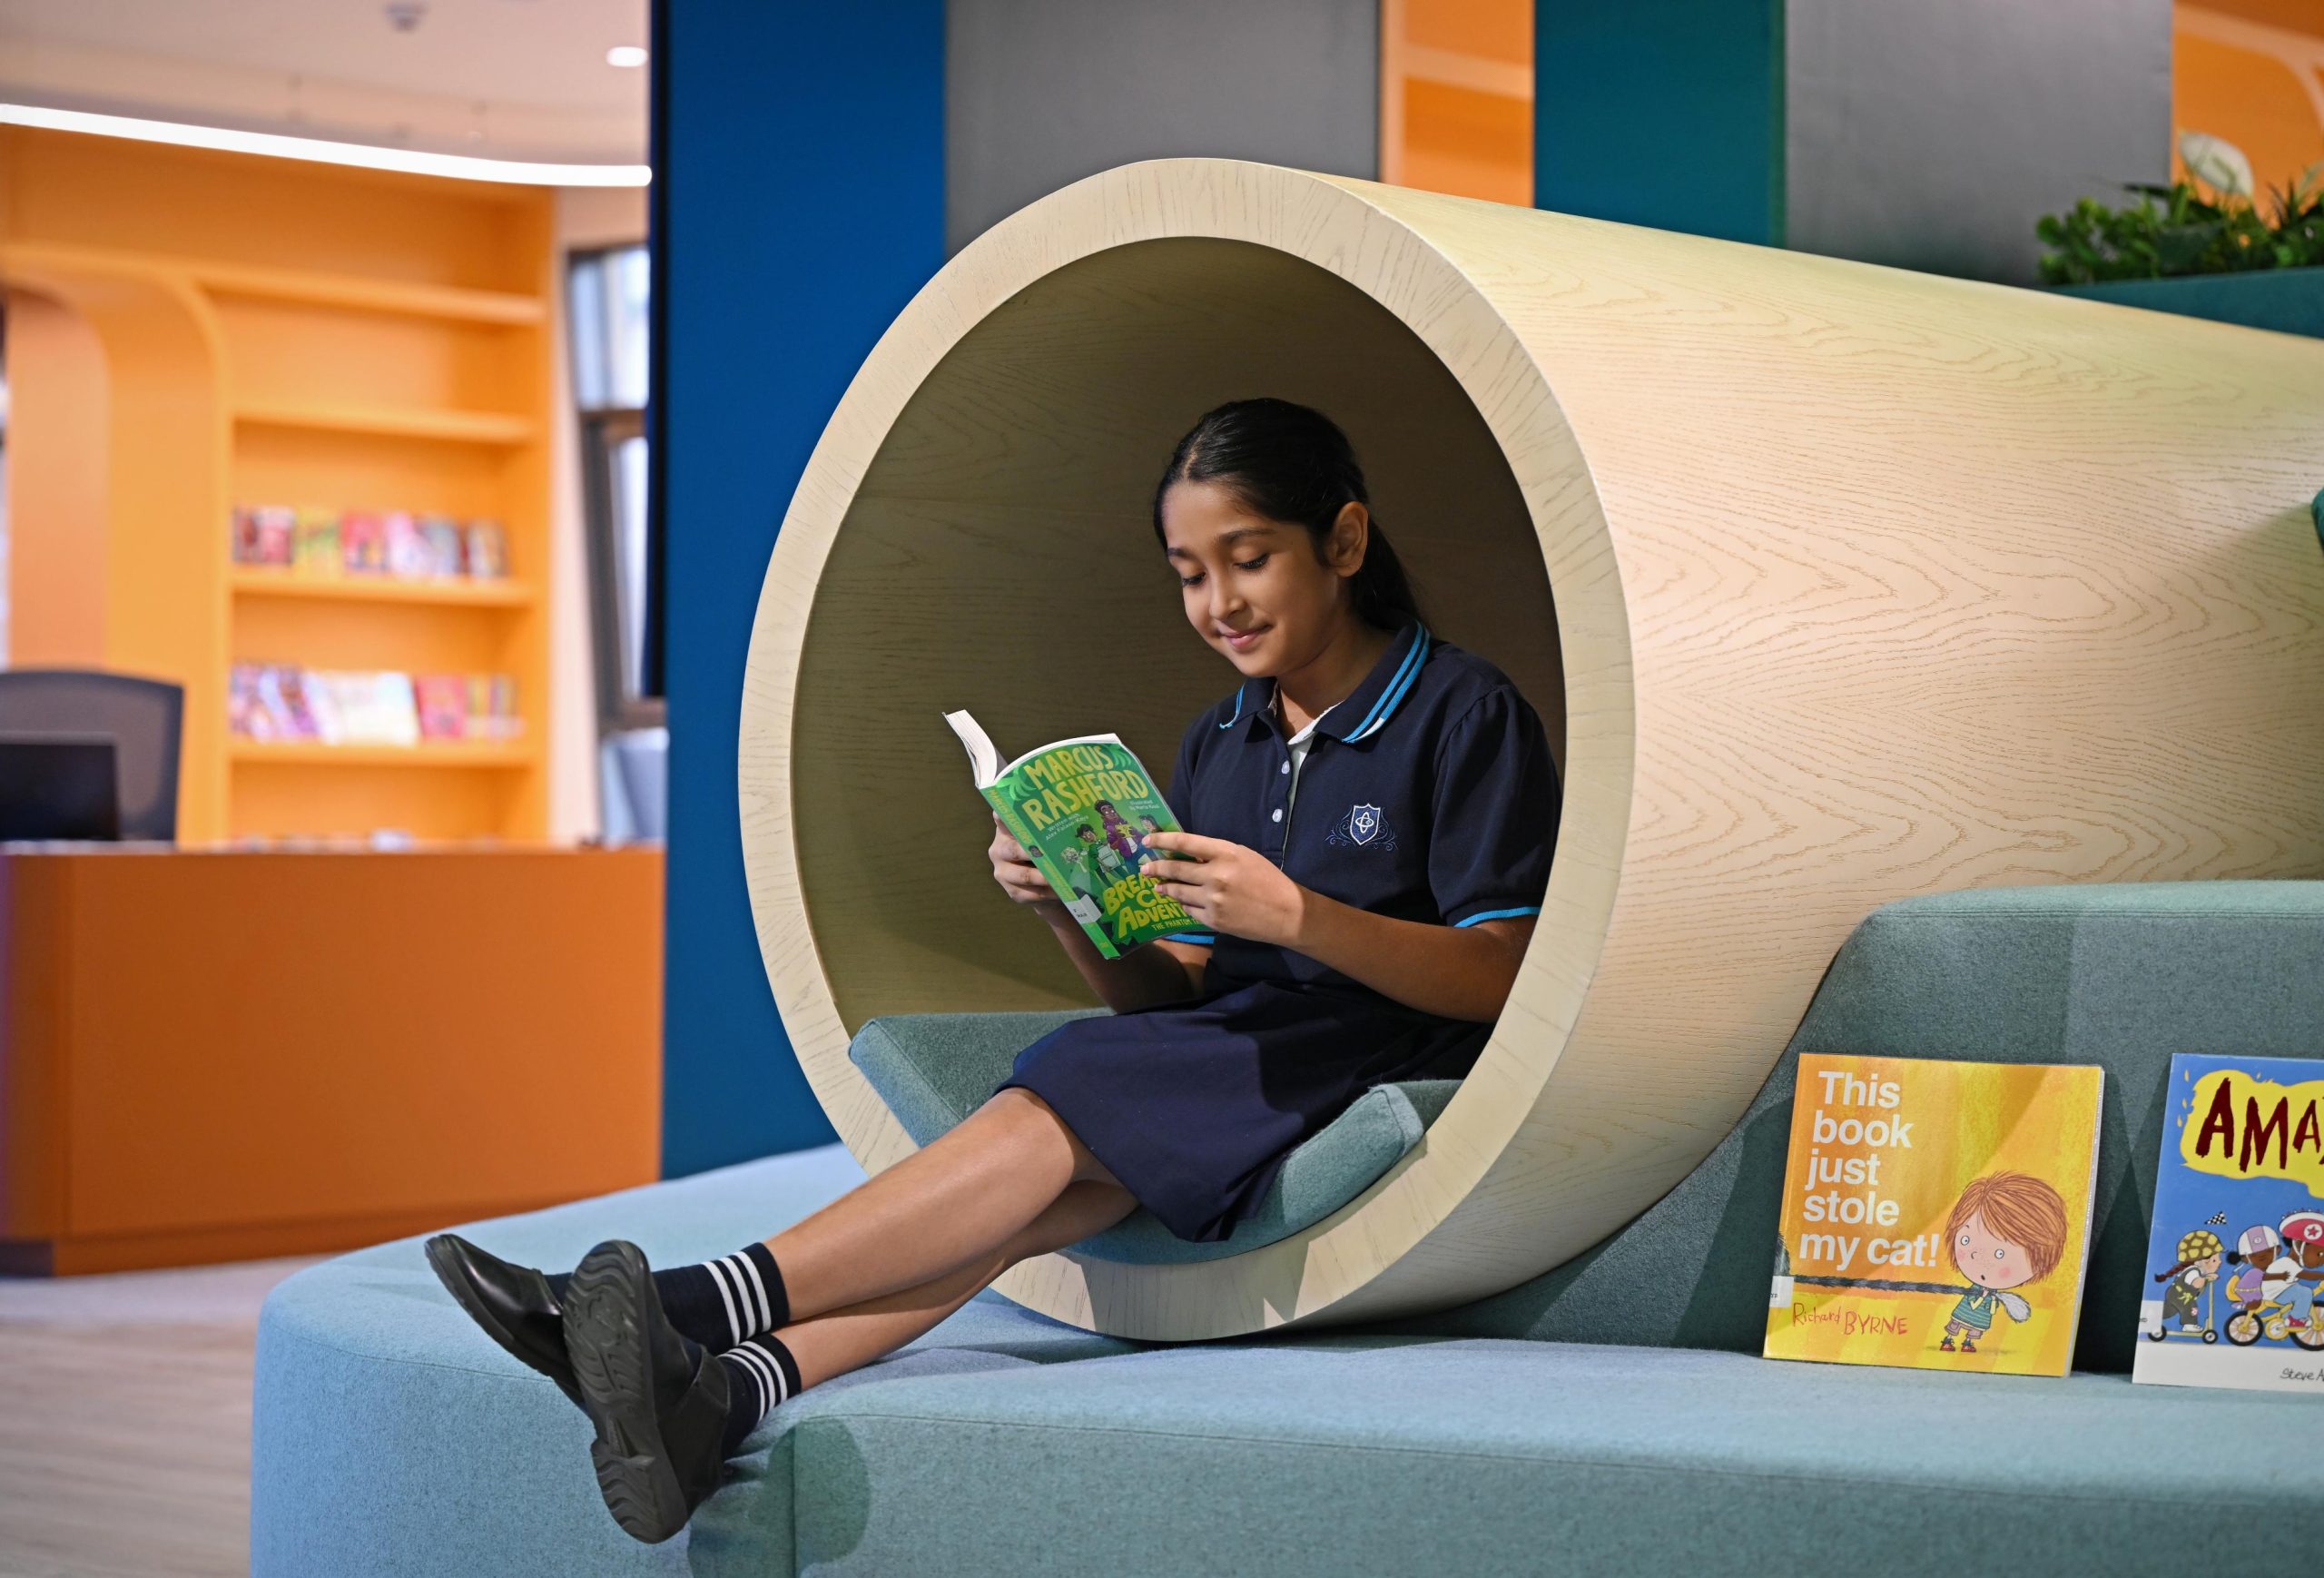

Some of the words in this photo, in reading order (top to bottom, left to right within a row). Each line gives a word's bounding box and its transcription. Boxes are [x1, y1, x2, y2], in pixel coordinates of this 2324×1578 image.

[1023, 745, 1114, 790] MARCUS
[1021, 769, 1148, 832] RASHFORD
[1118, 902, 1188, 939] ADVENT
[1817, 1070, 1901, 1109] This
[1812, 1110, 1915, 1149] book
[2195, 1077, 2324, 1173] AMA
[1804, 1148, 1881, 1190] just
[1803, 1191, 1900, 1226] stole
[1798, 1232, 1861, 1271] my
[1866, 1233, 1940, 1267] cat!
[1792, 1302, 1843, 1327] Richard
[1844, 1310, 1909, 1336] BYRNE
[2280, 1366, 2315, 1381] Steve
[2315, 1367, 2324, 1382] A
